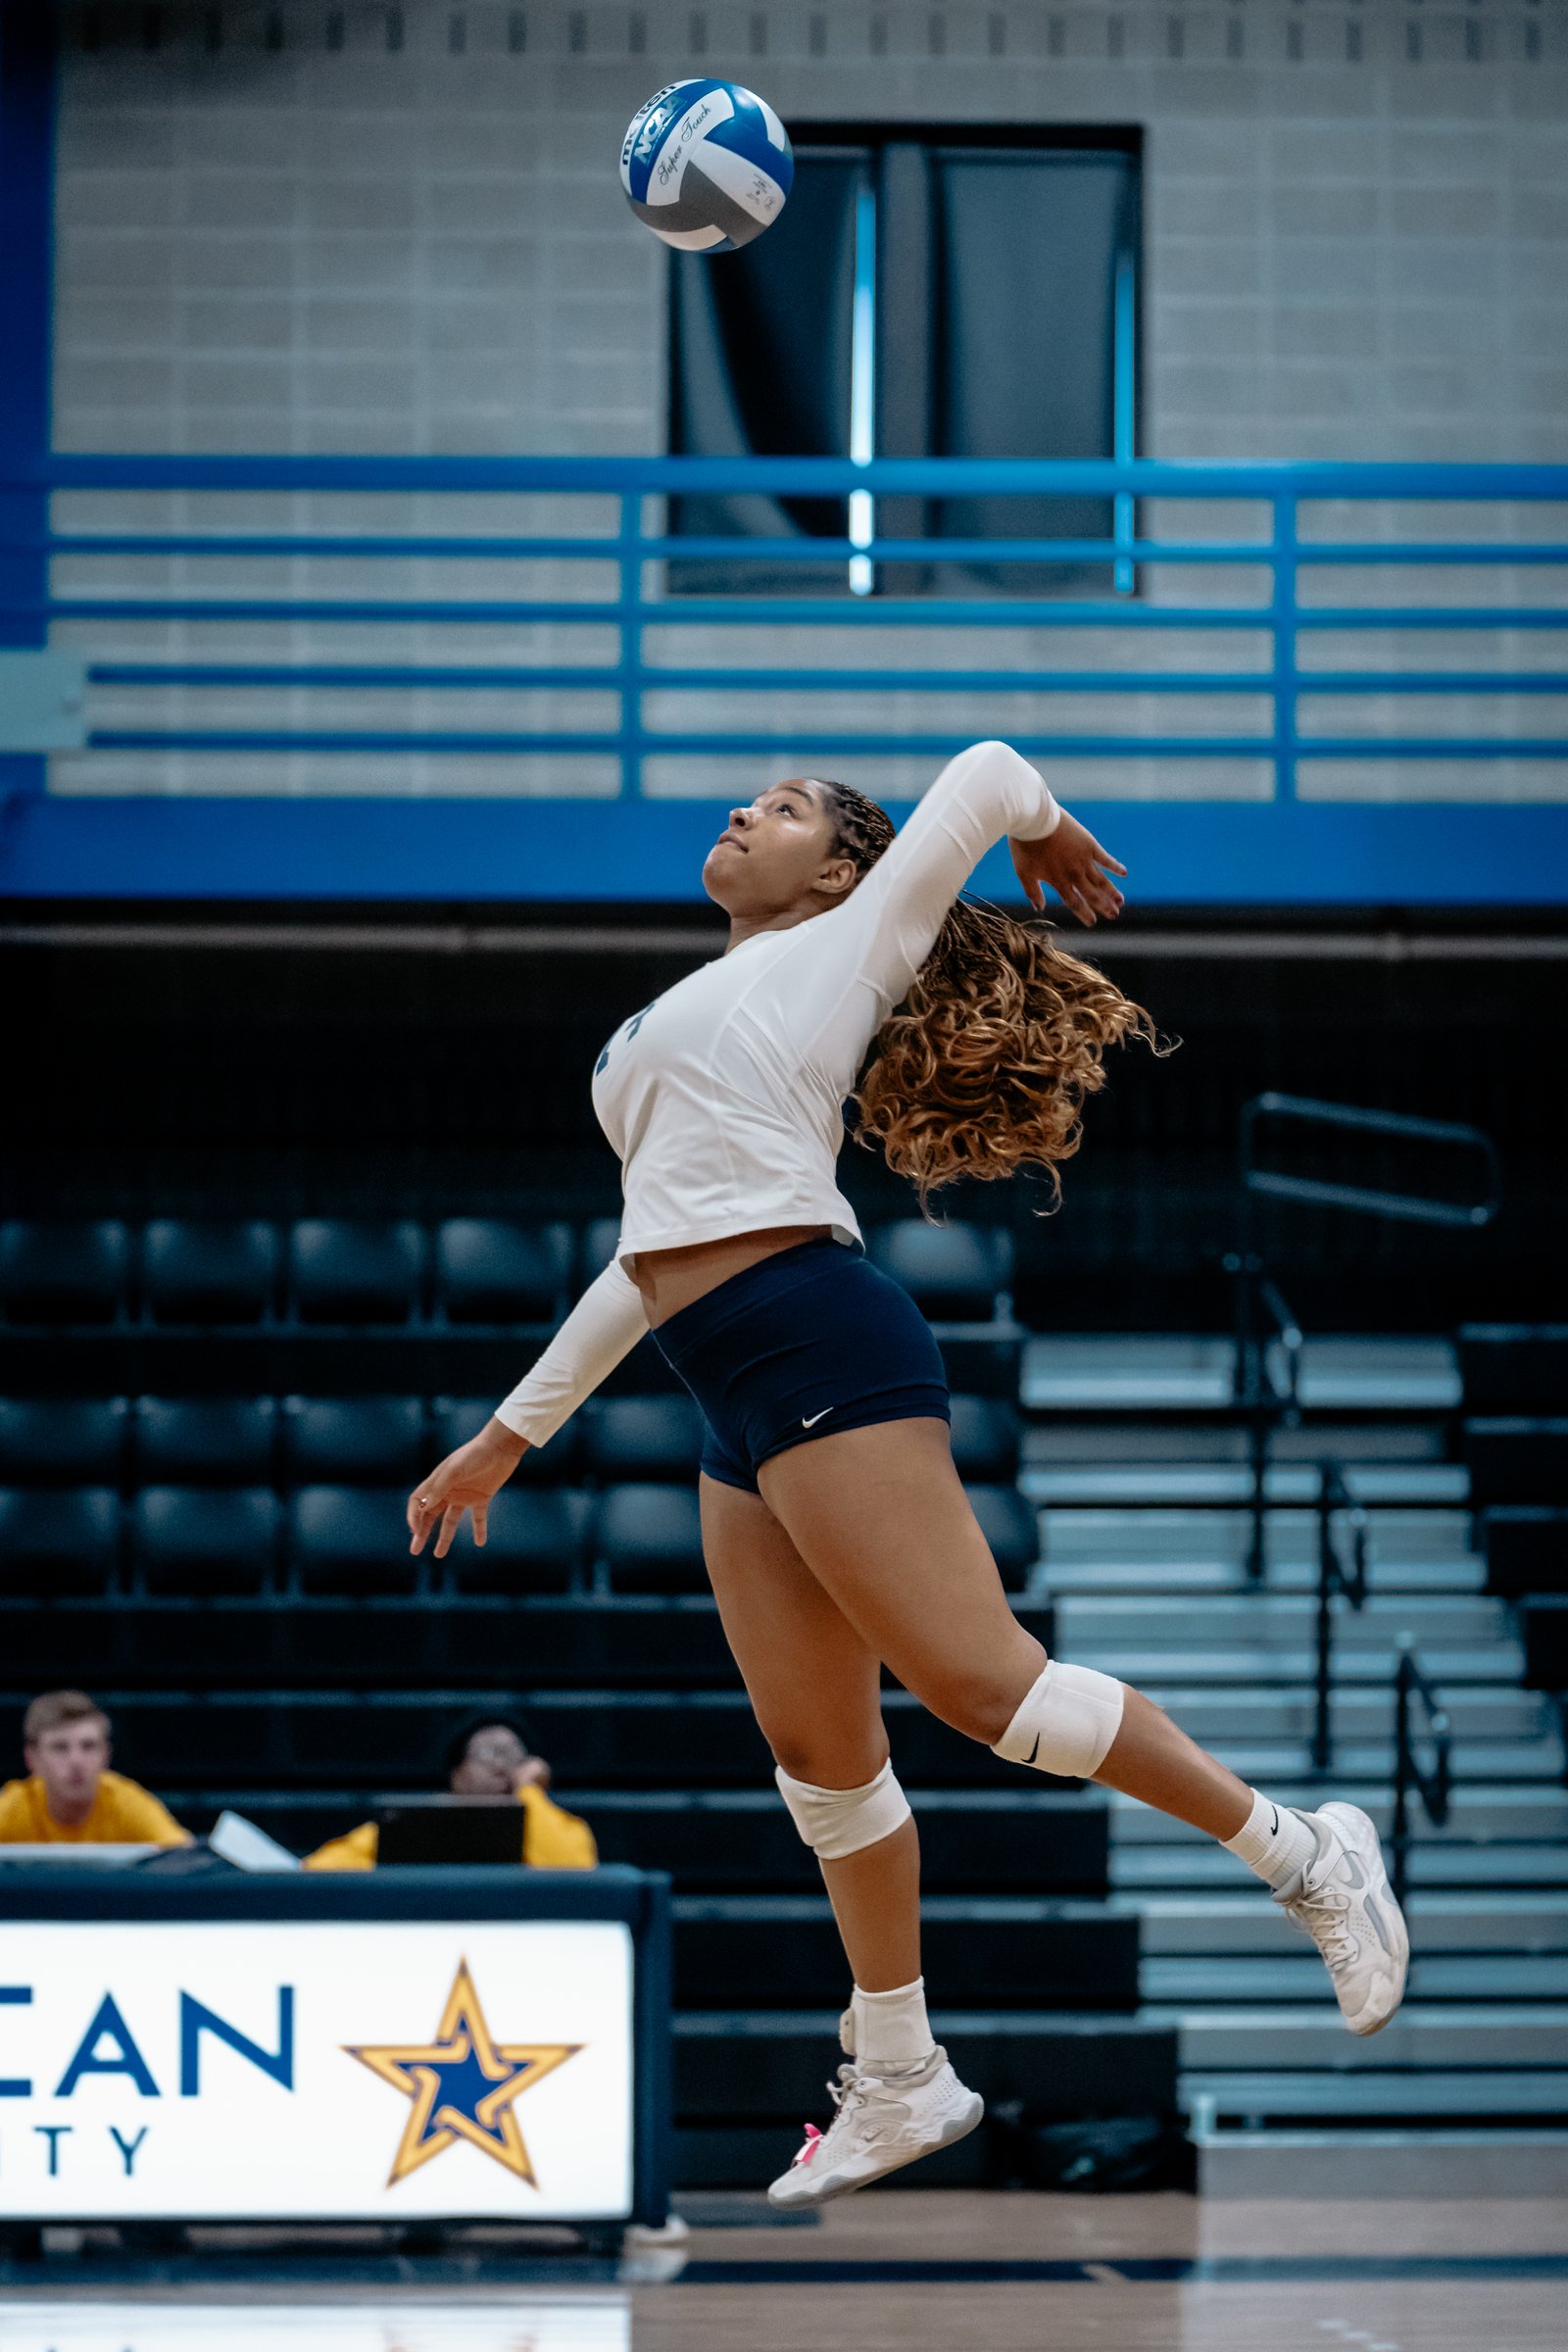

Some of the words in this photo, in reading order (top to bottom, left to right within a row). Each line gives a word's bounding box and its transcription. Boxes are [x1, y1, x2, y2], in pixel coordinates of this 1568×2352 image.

[622, 85, 676, 166] mlten
[634, 94, 685, 165] NCAA
[658, 144, 683, 185] Super
[681, 104, 711, 142] Touch
